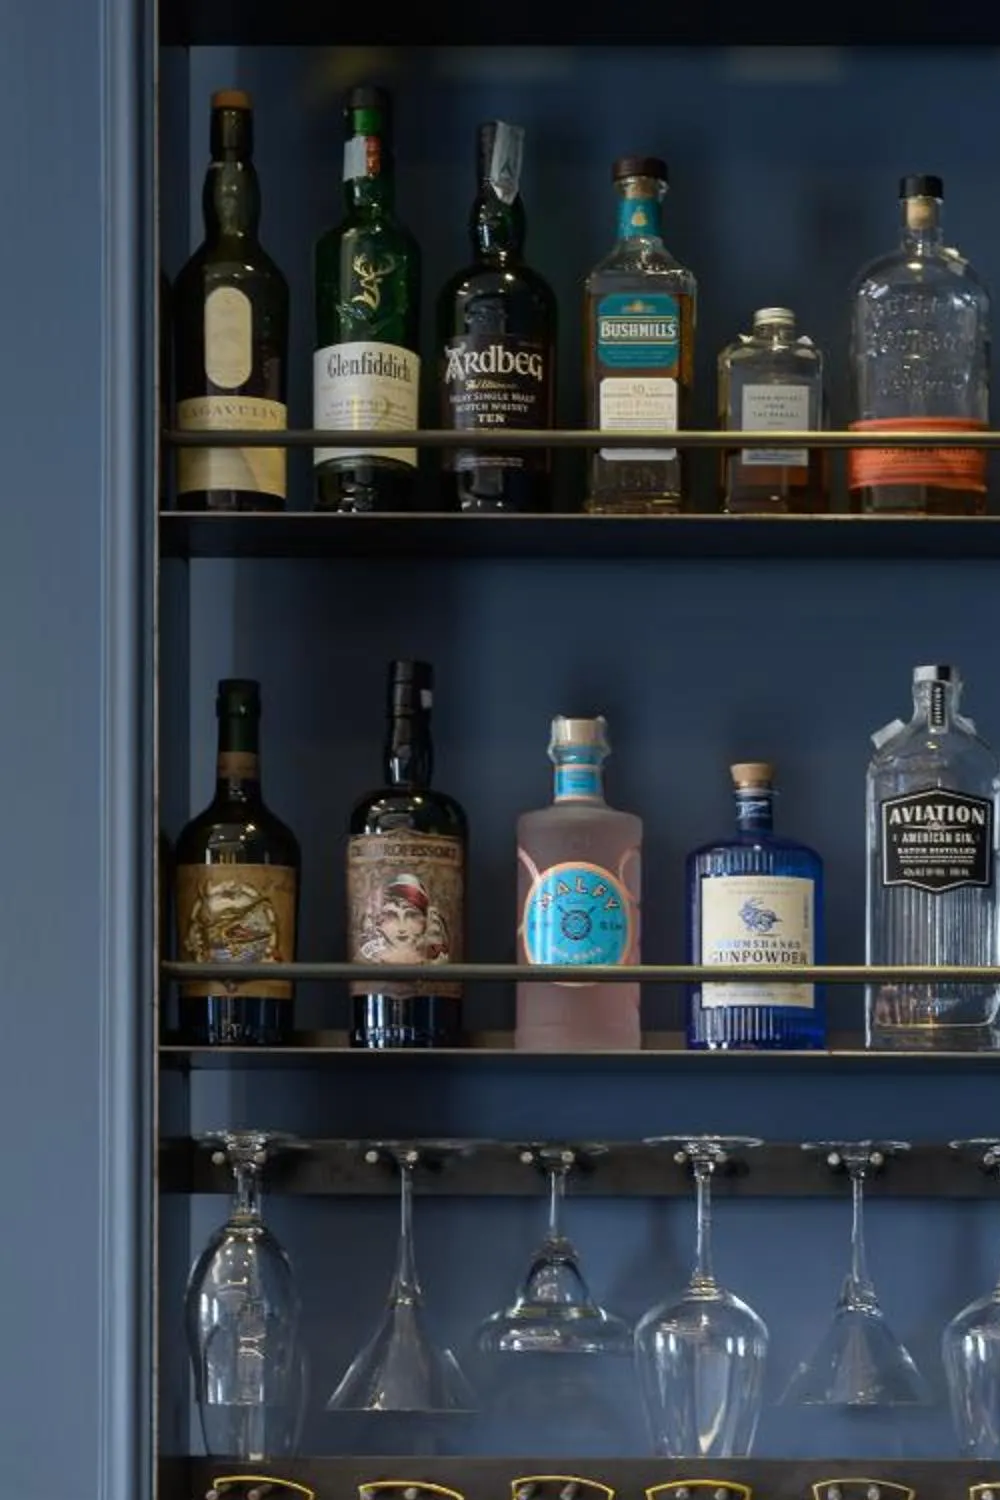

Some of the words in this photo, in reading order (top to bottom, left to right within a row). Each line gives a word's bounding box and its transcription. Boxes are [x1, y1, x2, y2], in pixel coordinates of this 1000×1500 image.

[601, 320, 677, 338] BUSHMILLS
[327, 351, 411, 382] Glenfiddich
[477, 413, 506, 424] TEN
[889, 804, 985, 825] AVIATION
[901, 832, 952, 844] AMERICAN
